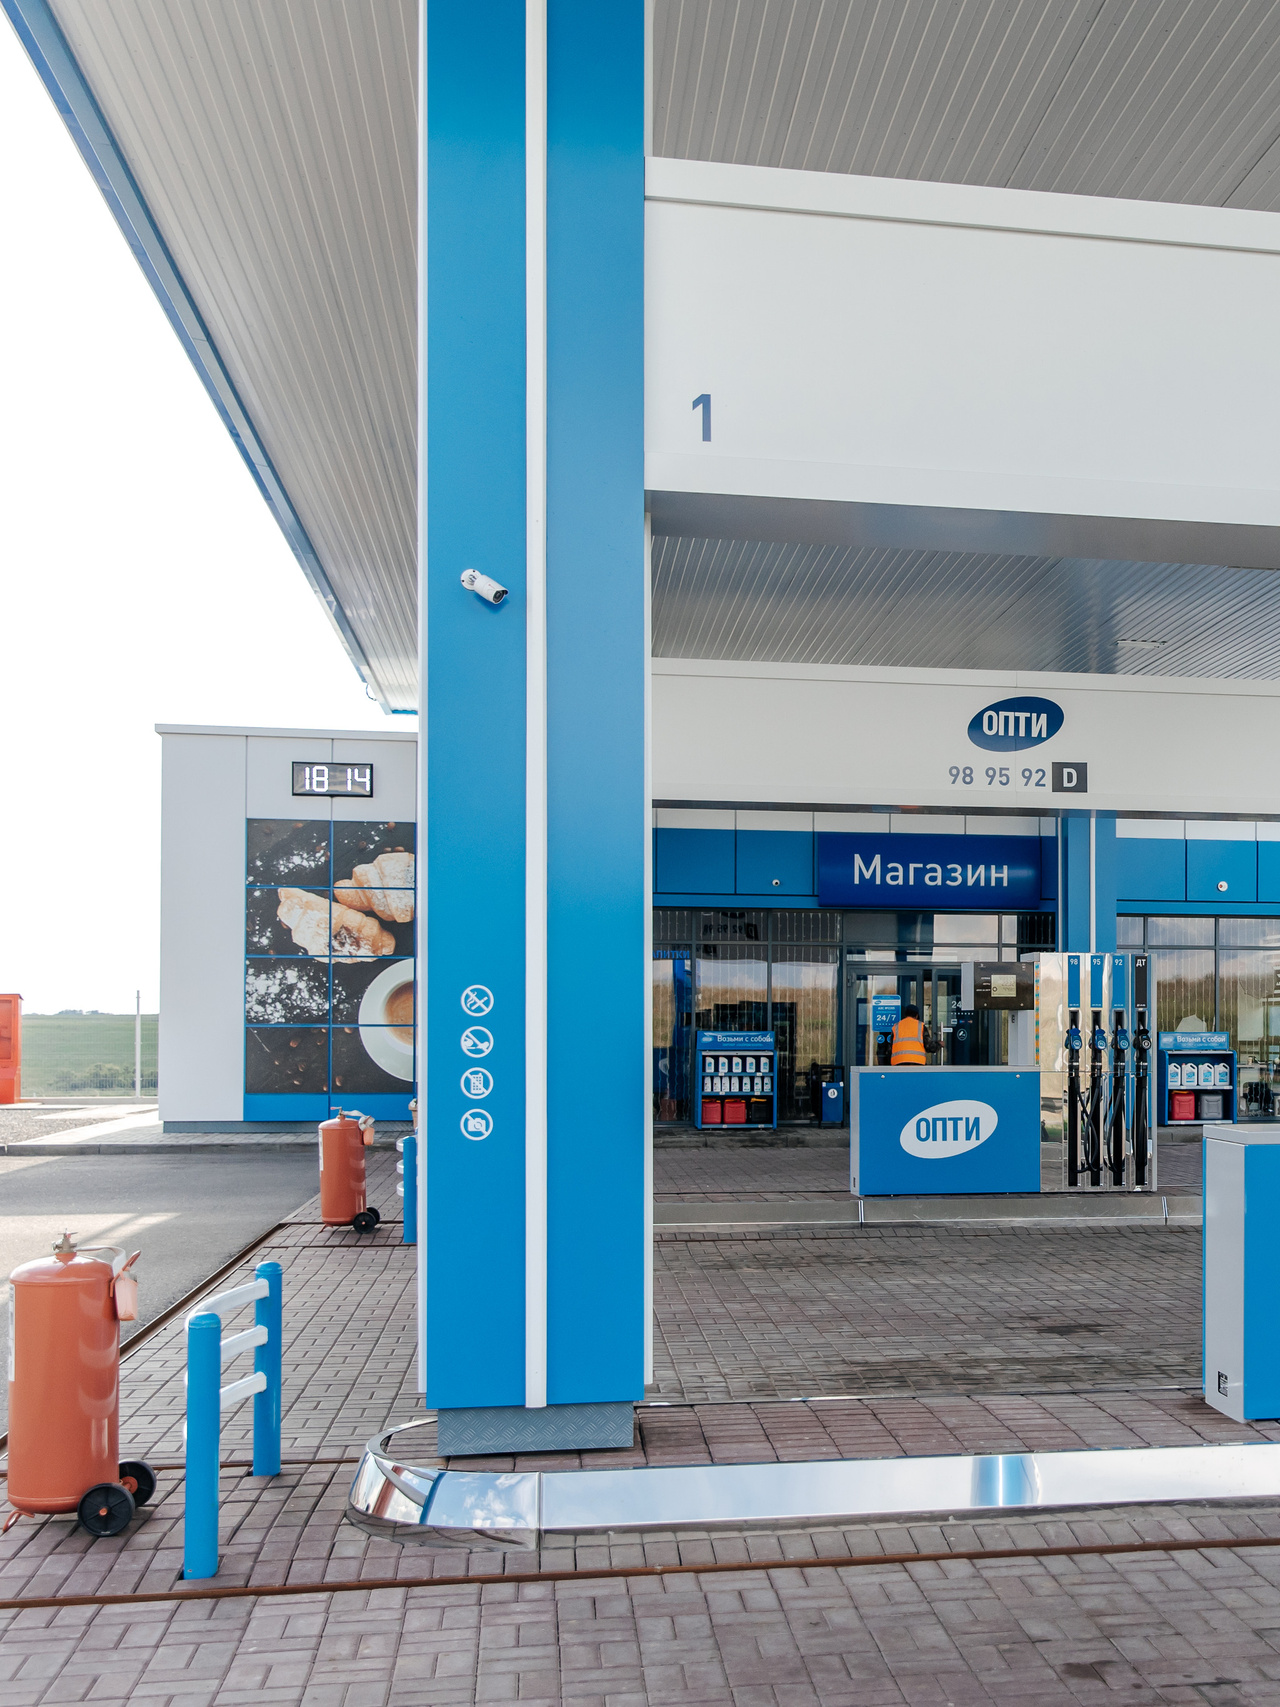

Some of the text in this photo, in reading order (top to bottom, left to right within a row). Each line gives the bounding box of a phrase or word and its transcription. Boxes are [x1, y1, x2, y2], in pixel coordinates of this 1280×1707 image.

[692, 393, 712, 442] 1
[982, 710, 1048, 738] ОПТИ
[304, 765, 371, 792] 18 14
[948, 765, 1078, 788] 98 95 92 D
[853, 853, 1009, 887] Магазин
[1135, 959, 1146, 967] ДТ
[717, 1034, 744, 1042] Возьми
[1176, 1035, 1201, 1043] Возьми
[1206, 1035, 1226, 1043] собой
[916, 1116, 980, 1142] ОПТИ
